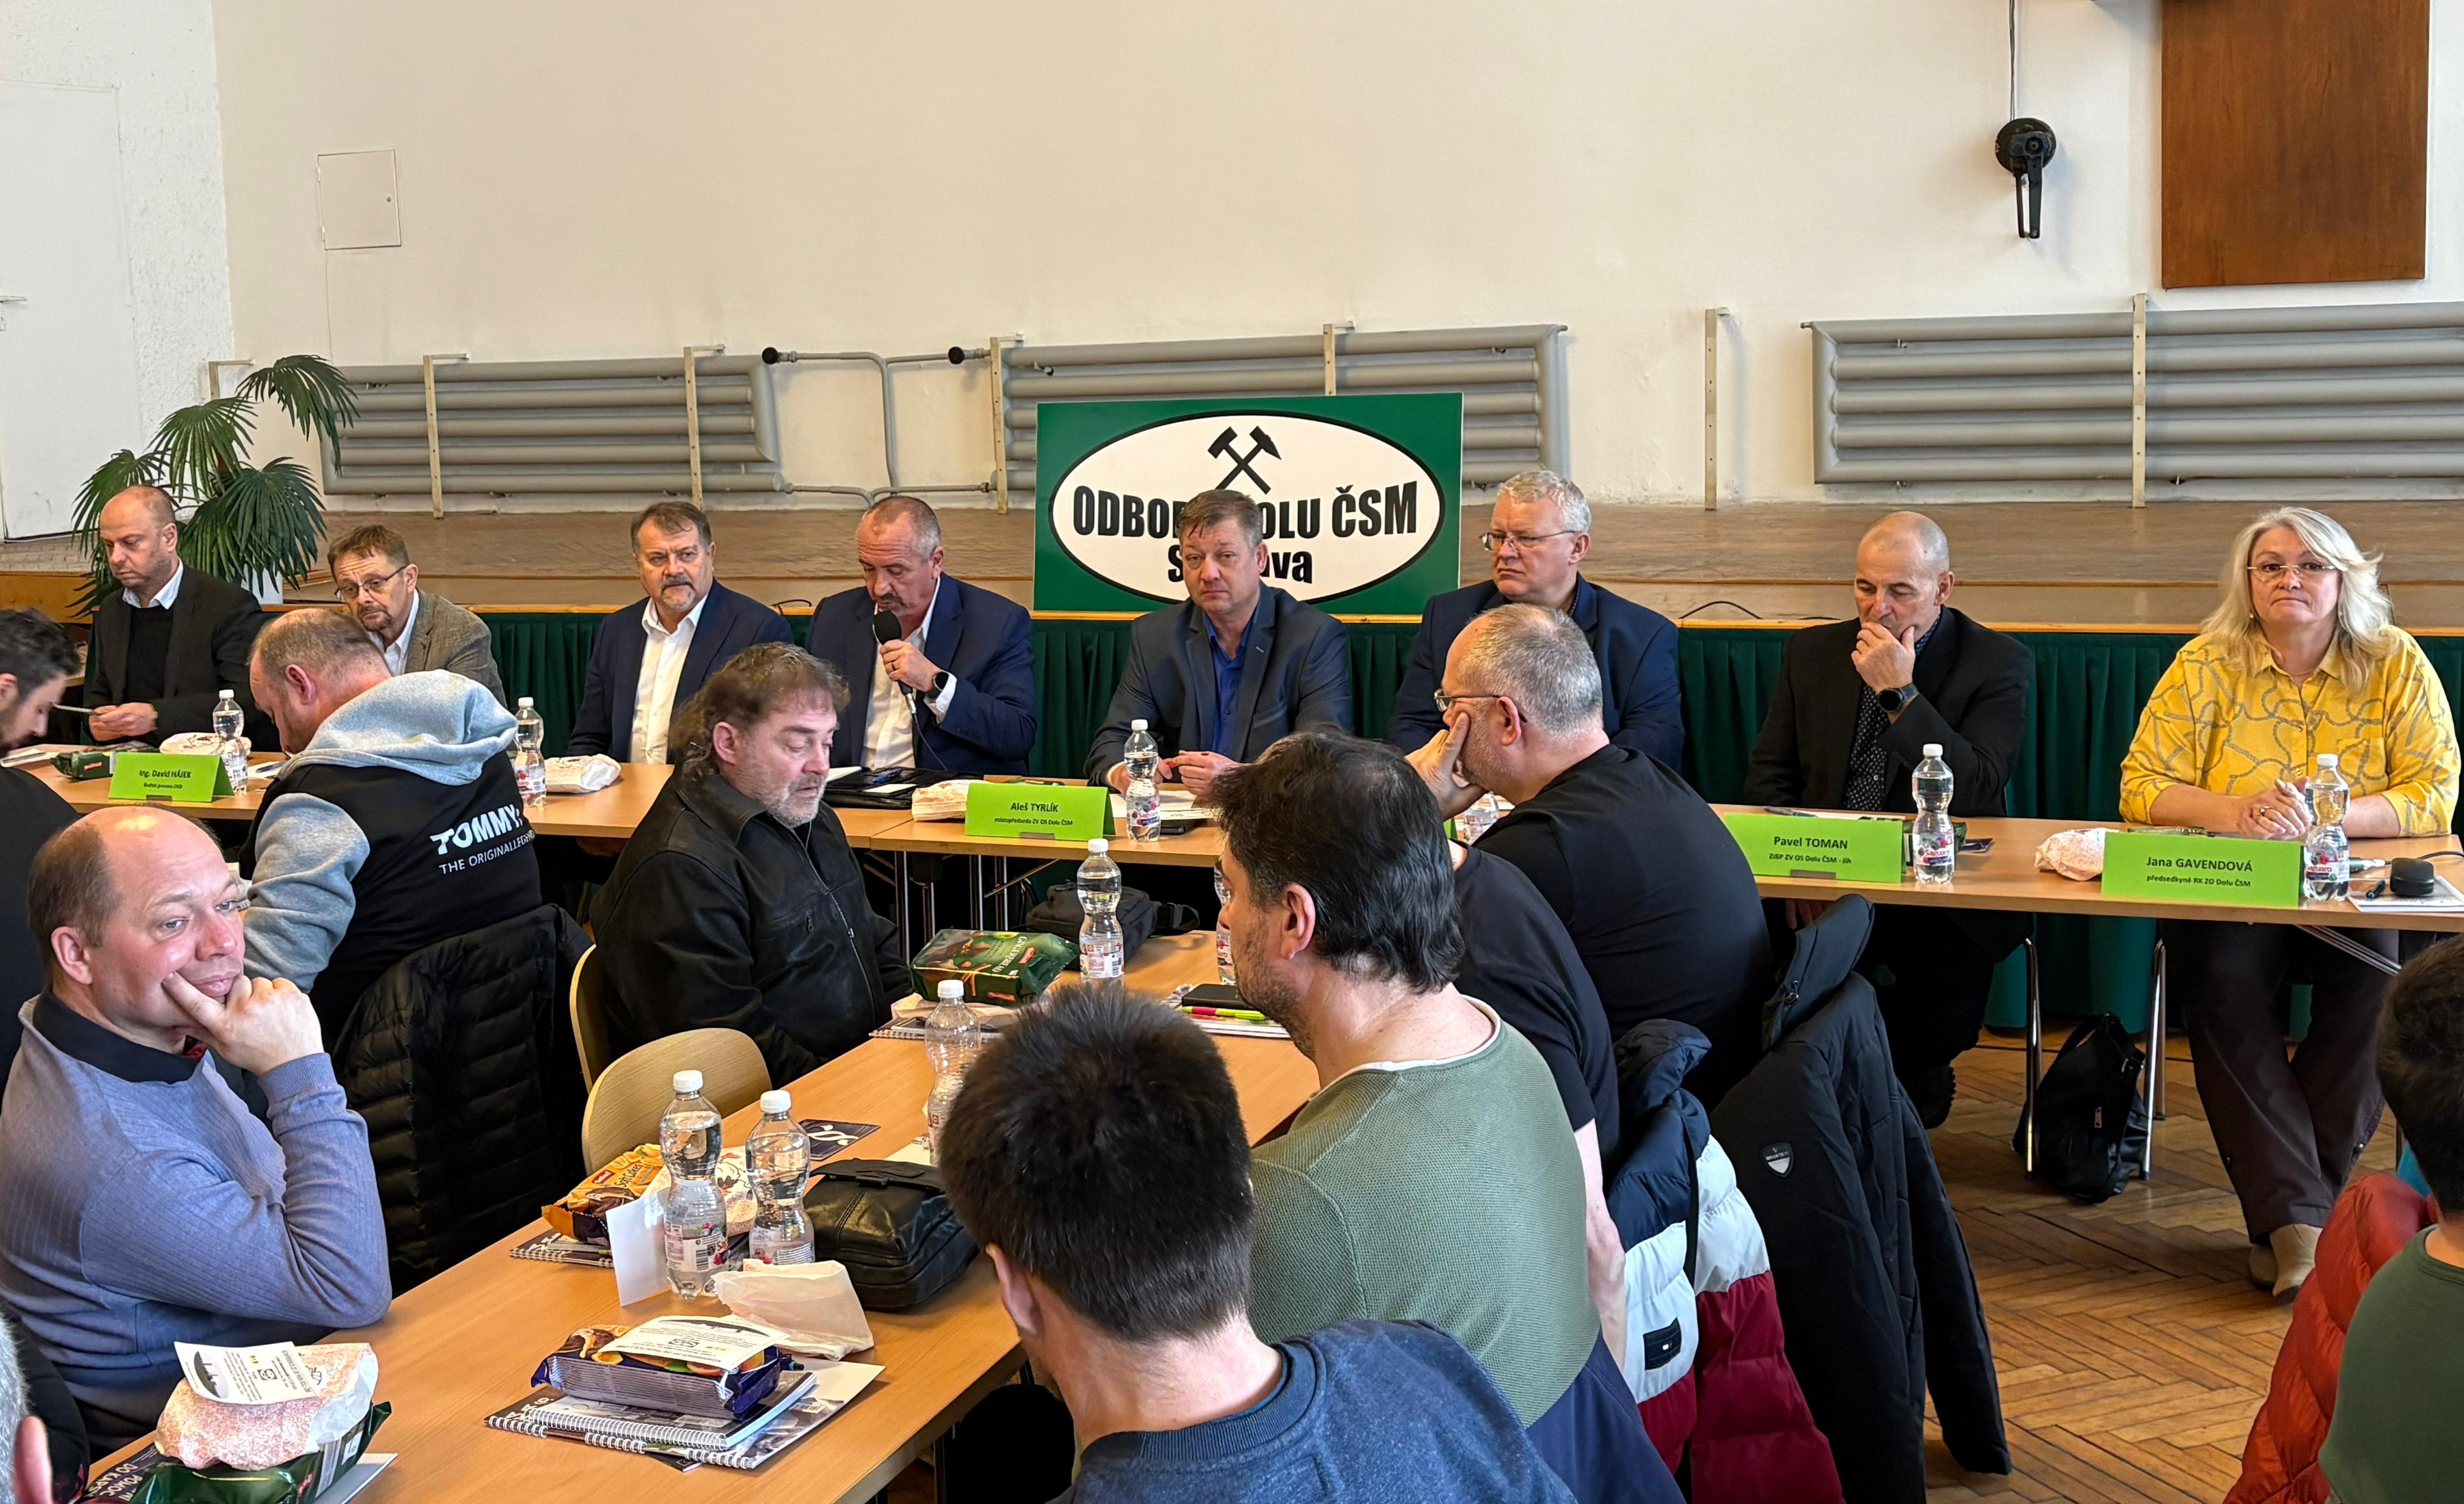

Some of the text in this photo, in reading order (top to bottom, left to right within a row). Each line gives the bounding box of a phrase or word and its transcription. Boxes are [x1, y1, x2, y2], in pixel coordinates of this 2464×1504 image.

[1073, 480, 1418, 539] ODBO OLU ČSM
[1010, 802, 1059, 812] Aleš TYRLÍK
[1774, 836, 1848, 849] Pavel TOMAN
[1822, 855, 1837, 863] ČSM
[2146, 856, 2253, 872] Jana GAVENDOVÁ
[439, 859, 465, 874] THE
[2146, 874, 2192, 884] předsedkyně
[2234, 879, 2251, 887] ČSM
[115, 1463, 138, 1474] DO
[99, 1474, 143, 1496] POMOC
